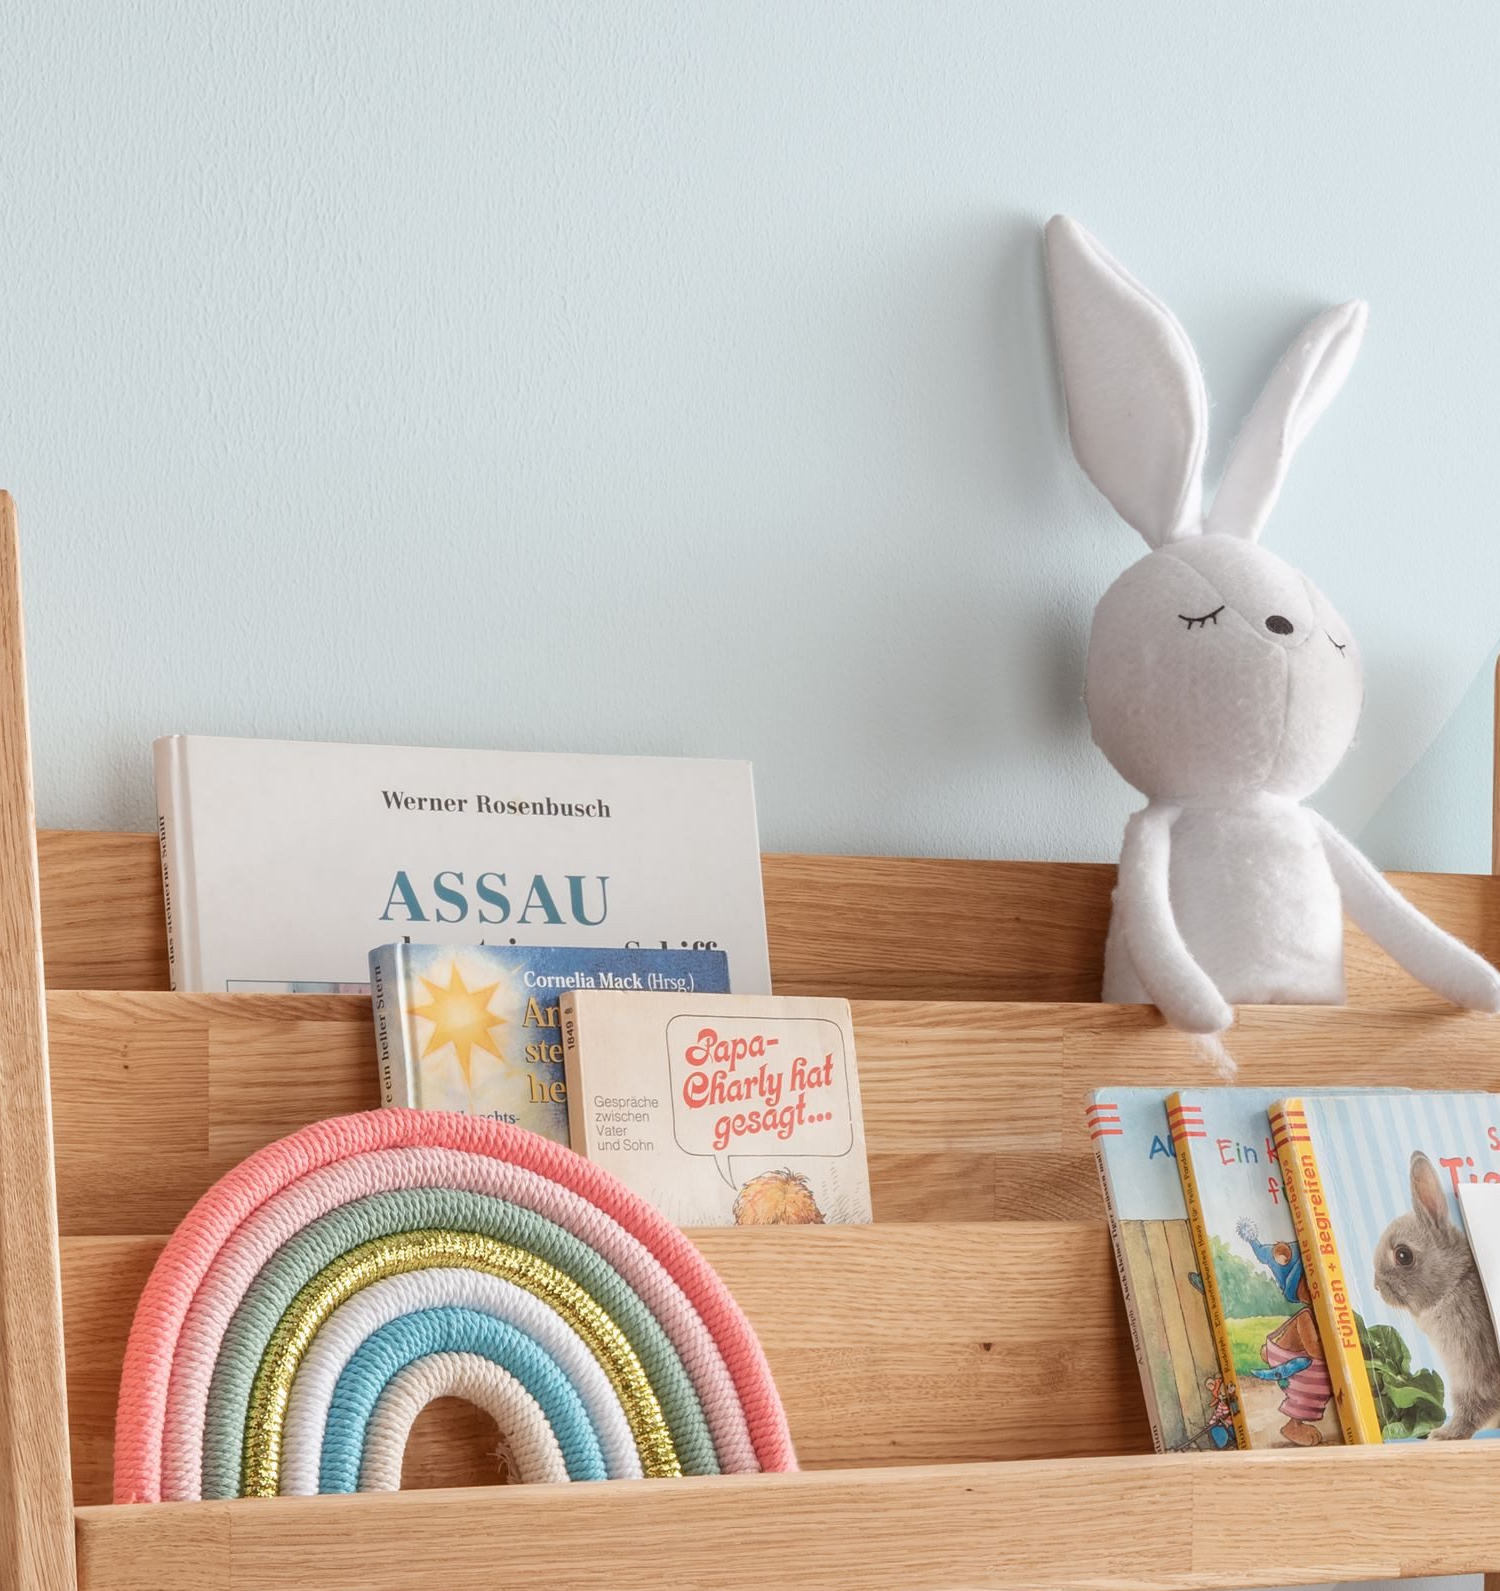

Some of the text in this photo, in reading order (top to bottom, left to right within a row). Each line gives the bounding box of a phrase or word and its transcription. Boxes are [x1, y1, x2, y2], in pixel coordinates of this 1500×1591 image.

[381, 790, 612, 818] Werner Rosenbusch
[378, 870, 610, 926] ASSAU
[374, 965, 385, 1010] Stern
[523, 970, 695, 992] Cornelia Mack (Hrsg.)
[378, 1014, 390, 1061] heller
[565, 1021, 576, 1050] 1849
[684, 1028, 779, 1073] Papa-
[383, 1065, 392, 1090] ein
[683, 1053, 834, 1110] Charly hat
[593, 1095, 659, 1110] Gespräche
[595, 1110, 650, 1122] zwischen
[595, 1124, 628, 1137] Vater
[712, 1093, 832, 1150] gesagt...
[597, 1138, 654, 1151] und Sohn
[1216, 1138, 1259, 1166] Ein
[1180, 1152, 1190, 1181] Panda
[1300, 1154, 1335, 1256] Begreifen
[1109, 1214, 1118, 1240] Tiger
[1195, 1224, 1205, 1248] Haus
[1283, 1160, 1321, 1300] So viele Tierbabys
[1121, 1275, 1131, 1301] Auch
[1330, 1279, 1357, 1350] Fühlen
